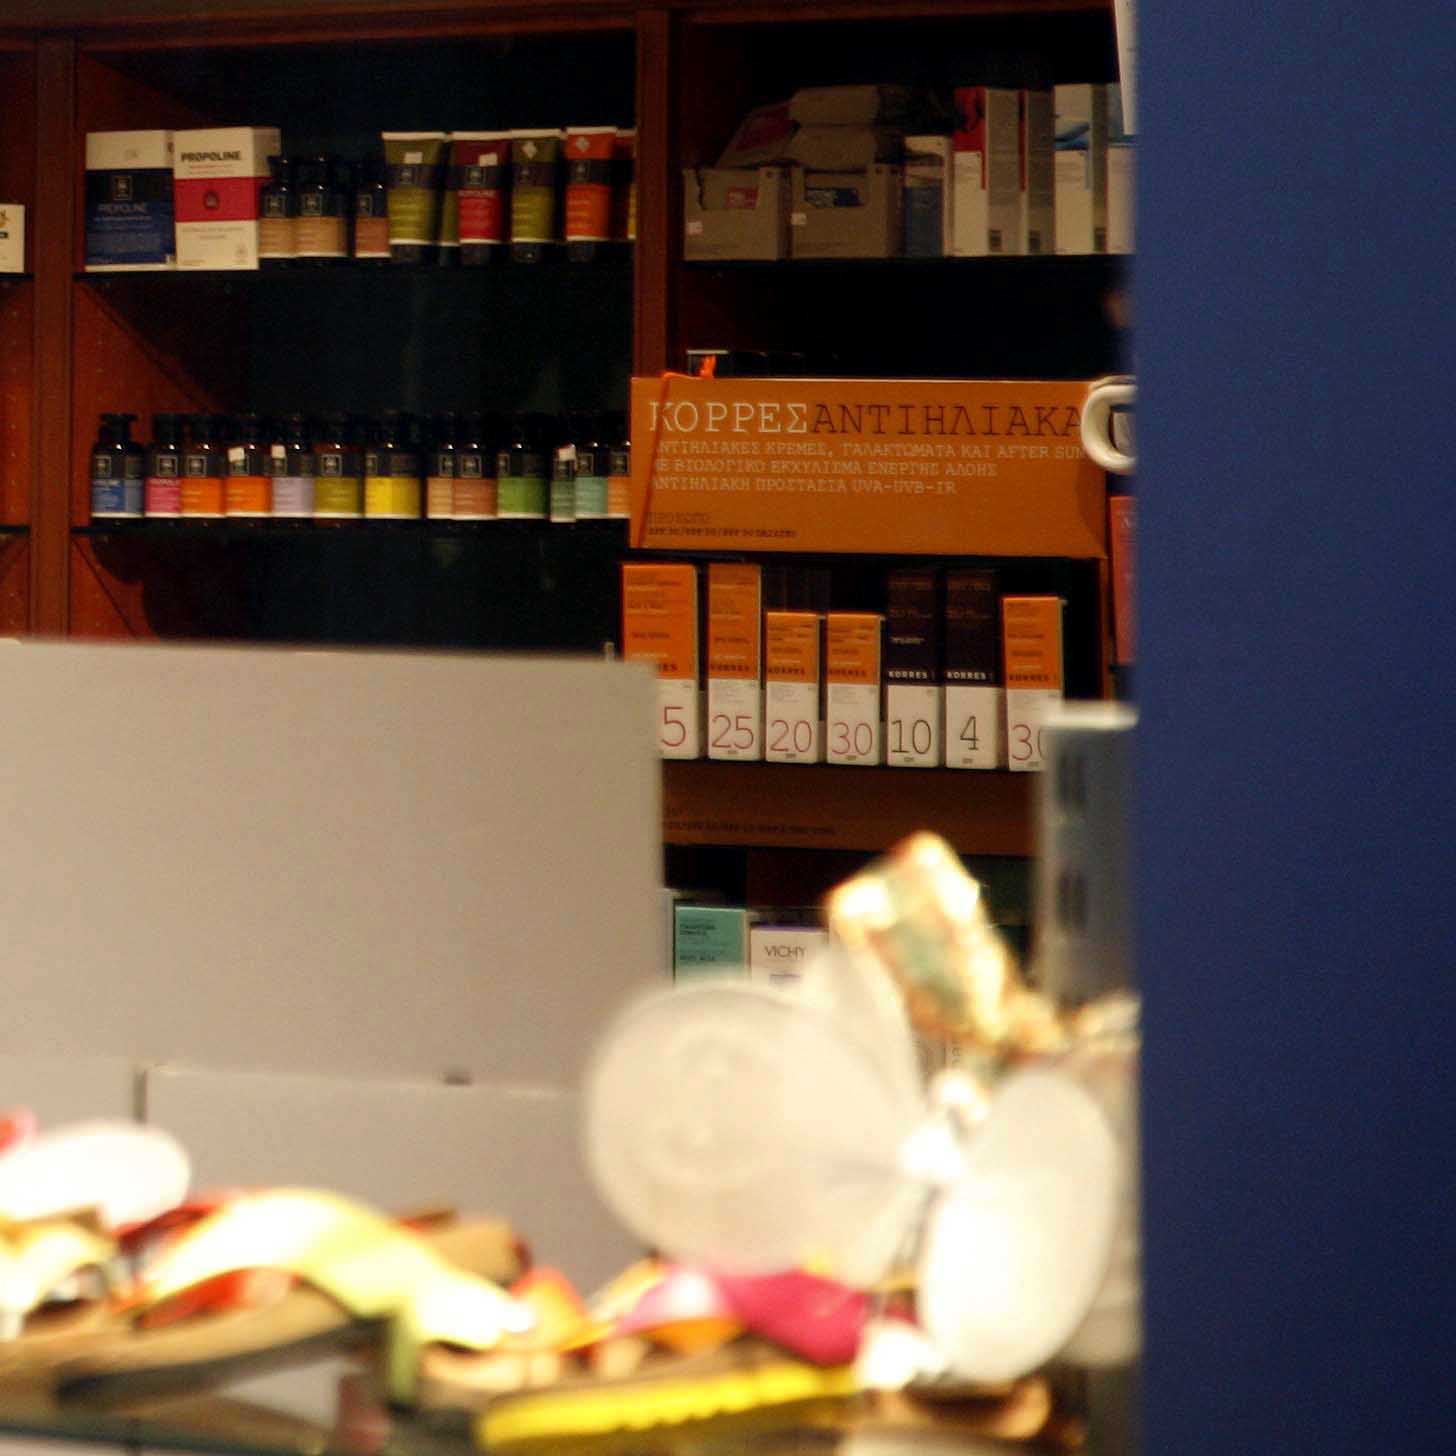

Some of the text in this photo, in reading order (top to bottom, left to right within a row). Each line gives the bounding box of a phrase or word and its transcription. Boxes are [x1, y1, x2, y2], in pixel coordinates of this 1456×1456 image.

[660, 706, 688, 749] 5
[711, 713, 756, 751] 25
[769, 719, 814, 754] 20
[831, 722, 874, 758] 30
[890, 719, 932, 756] 10
[959, 715, 981, 752] 4
